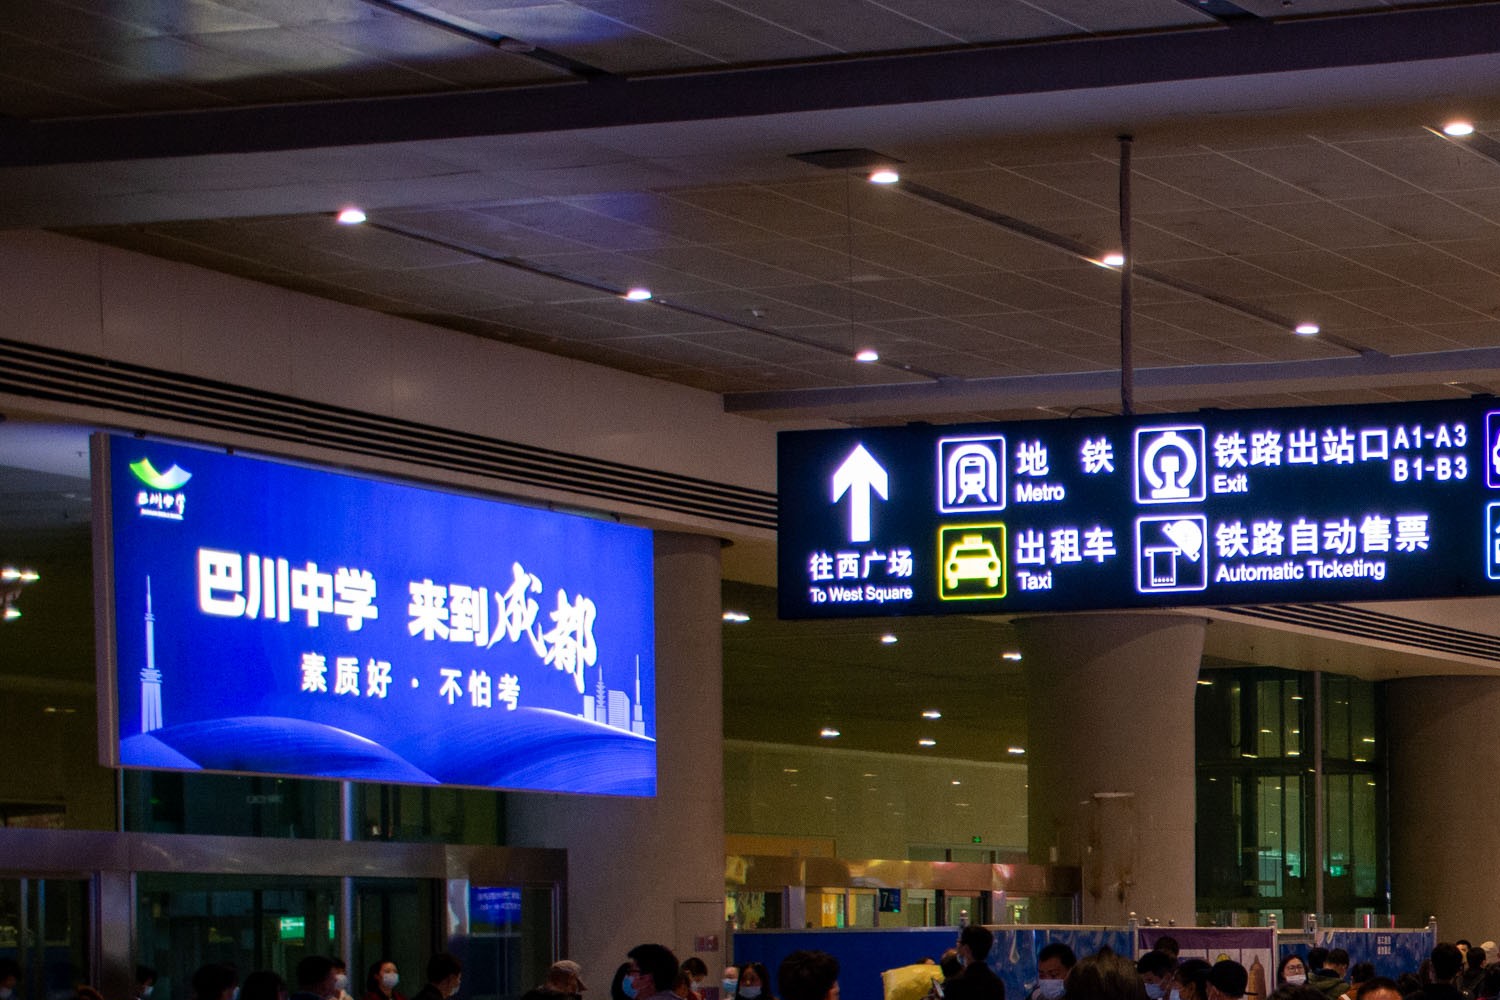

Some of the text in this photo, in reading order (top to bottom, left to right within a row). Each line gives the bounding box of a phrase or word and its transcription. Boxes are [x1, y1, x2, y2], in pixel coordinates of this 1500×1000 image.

[1213, 427, 1389, 469] 铁路出站口
[1393, 423, 1467, 449] A1-A3
[1016, 437, 1115, 477] 地铁
[1393, 455, 1468, 482] B1-B3
[1015, 482, 1065, 503] Metro
[1213, 473, 1248, 494] Exit
[1016, 526, 1117, 566] 出租车
[1215, 514, 1430, 561] 铁路自动售票
[809, 549, 913, 581] 往西广场
[1215, 558, 1386, 583] Automatic Ticketing
[1016, 570, 1052, 590] Taxi
[809, 585, 913, 603] To West Square
[198, 547, 599, 695] 巴川中学 来到成都
